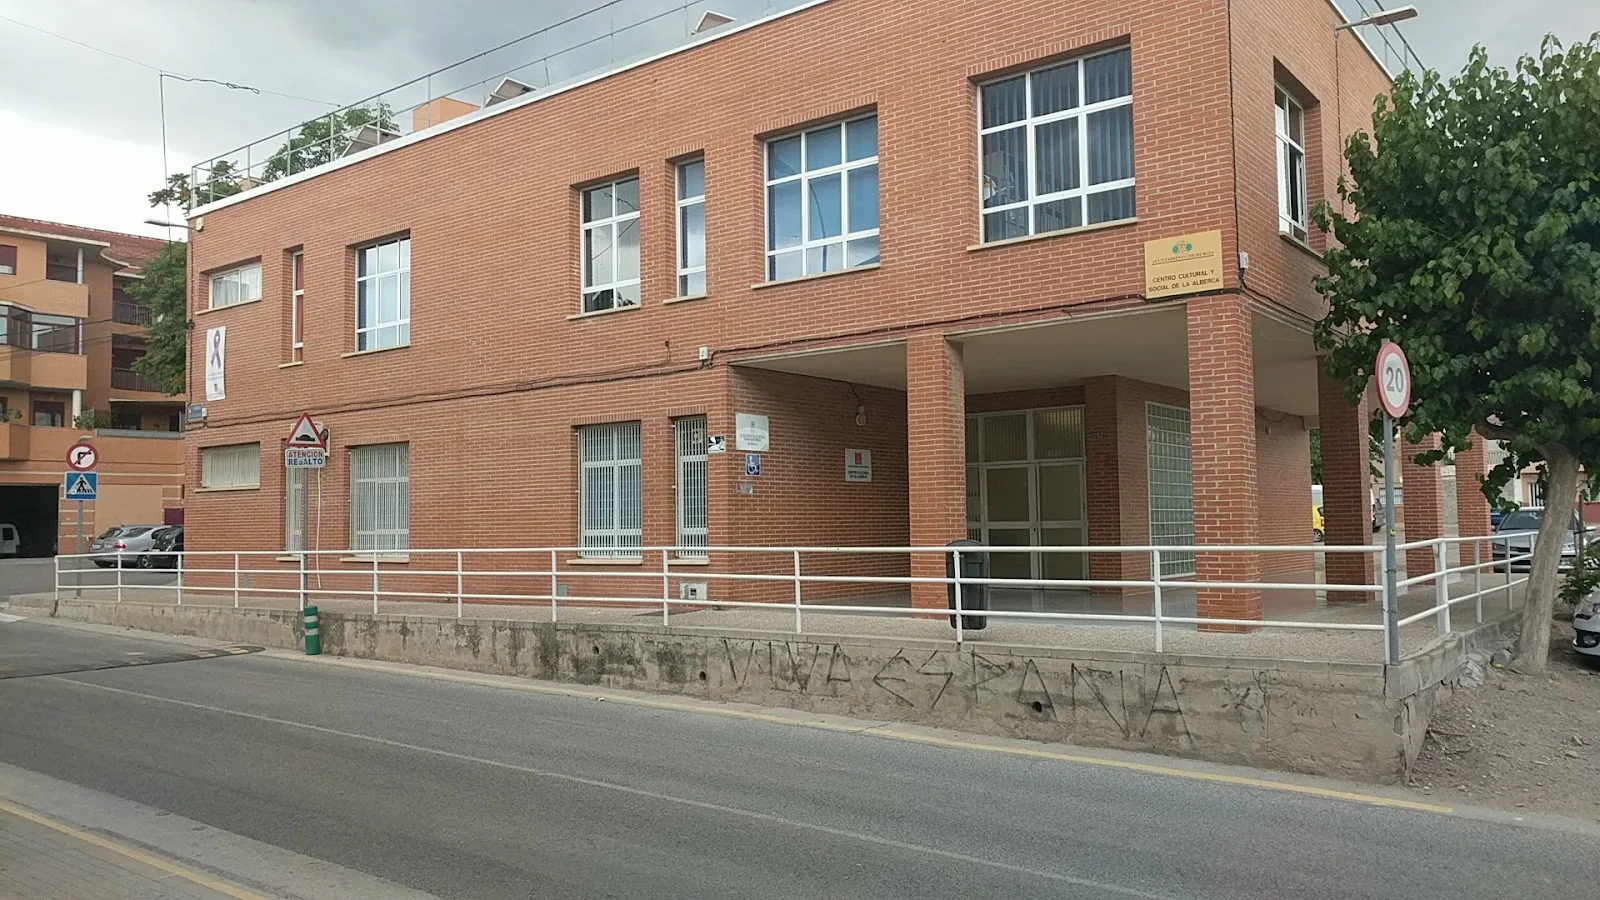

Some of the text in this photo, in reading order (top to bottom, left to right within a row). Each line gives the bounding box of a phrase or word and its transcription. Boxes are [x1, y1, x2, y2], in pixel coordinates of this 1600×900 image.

[1148, 284, 1169, 292] SOCIAL
[1192, 277, 1220, 286] ALBERCA
[1152, 274, 1176, 283] CENTRO
[1178, 270, 1208, 280] CULTURAL
[1385, 366, 1404, 393] 20
[723, 638, 857, 697] VIVA
